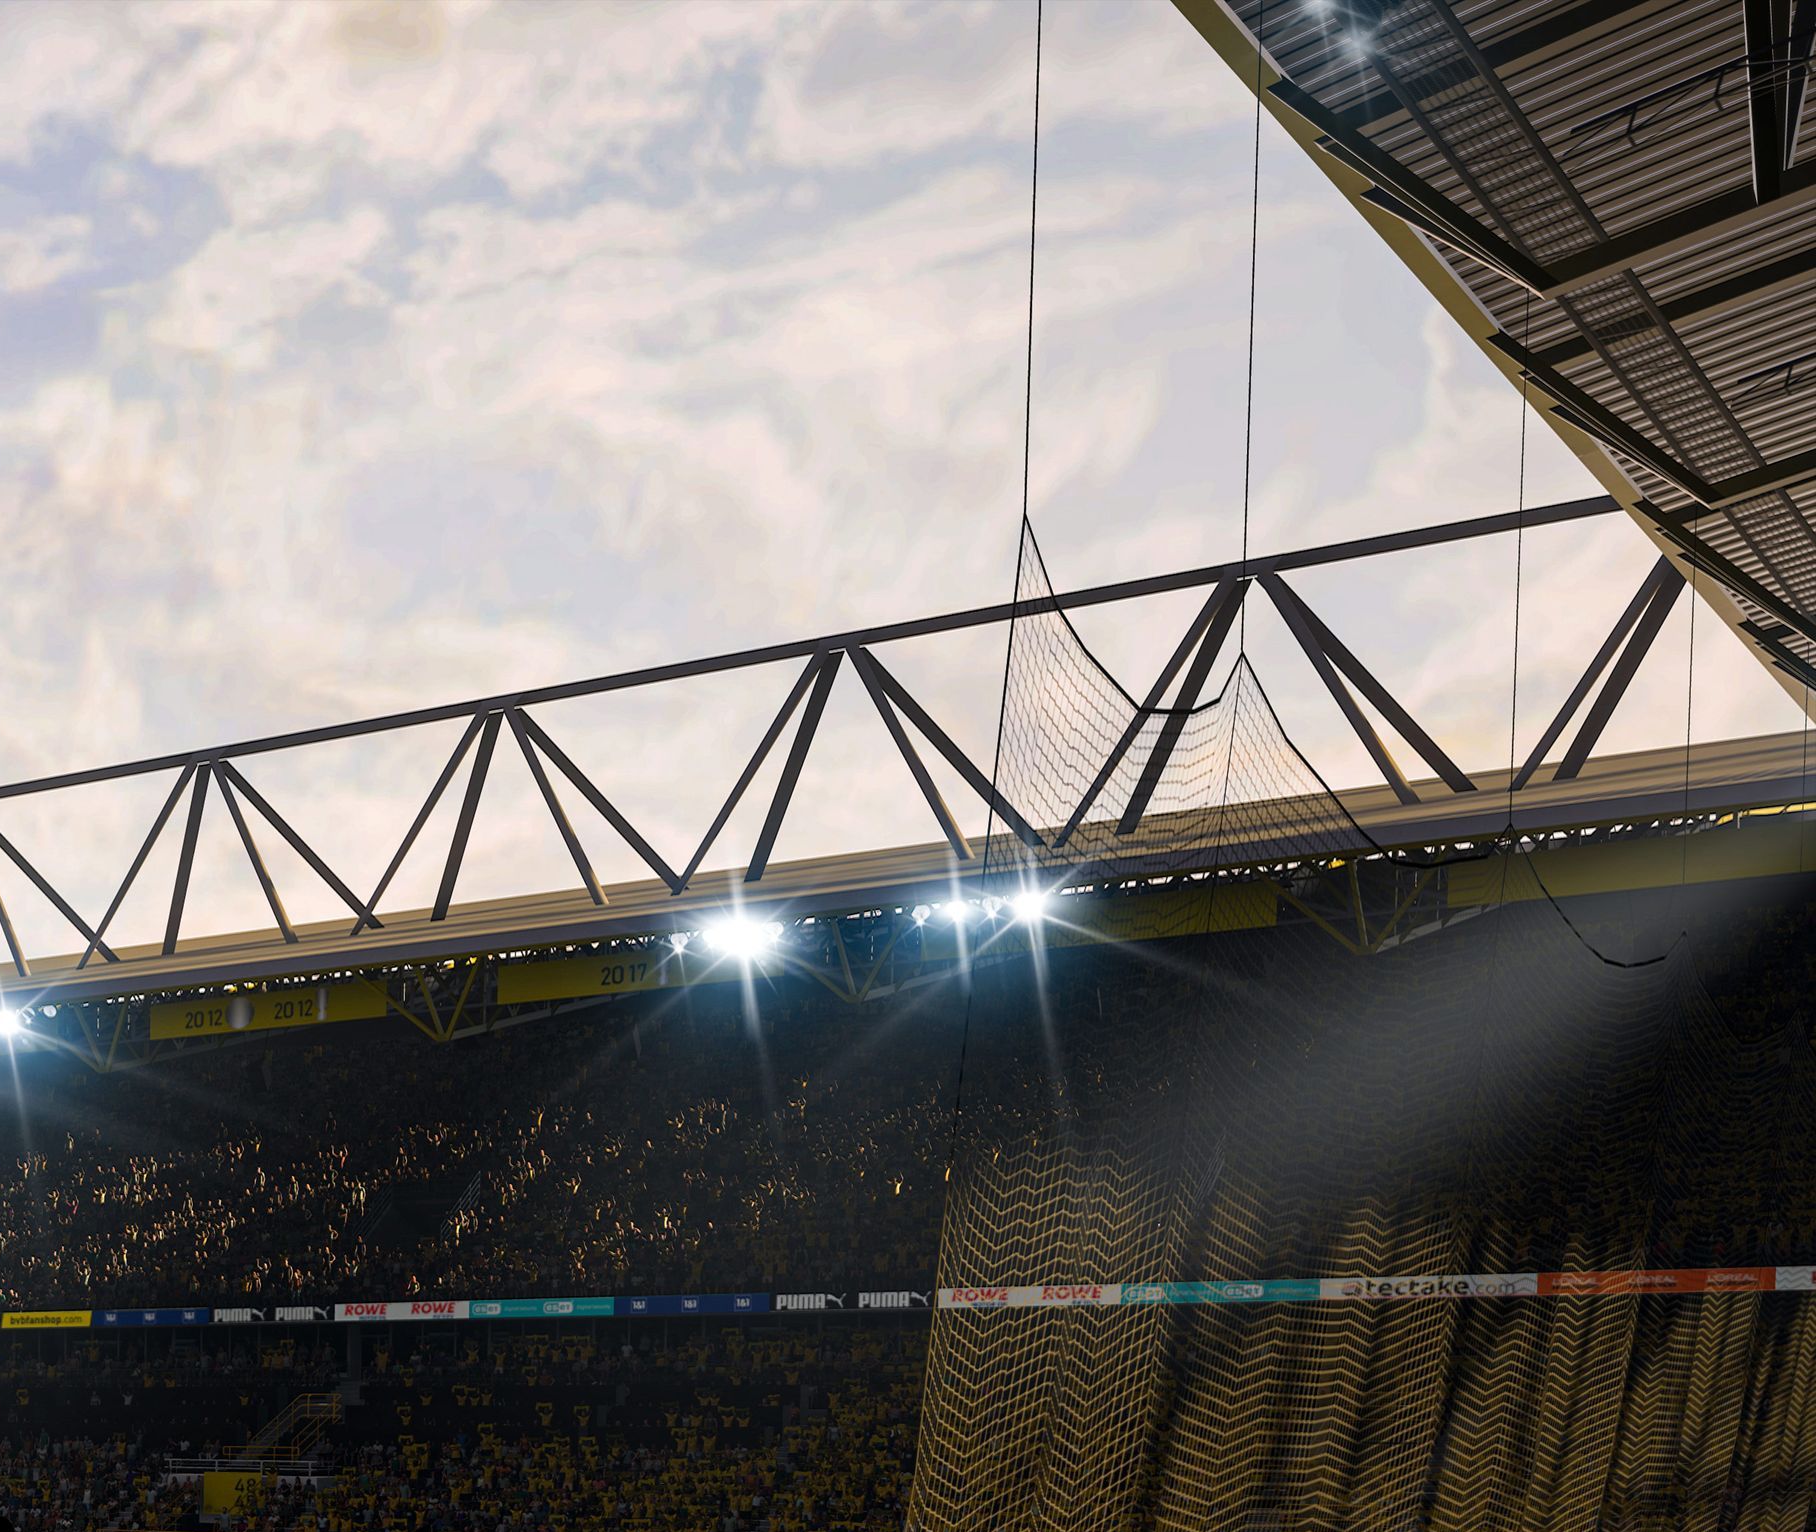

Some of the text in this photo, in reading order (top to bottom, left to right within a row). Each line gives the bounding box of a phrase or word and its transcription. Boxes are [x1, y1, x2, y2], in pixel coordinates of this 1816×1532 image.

[274, 1000, 313, 1020] 2012
[184, 1012, 223, 1029] 2012
[859, 1291, 909, 1309] PUMA
[951, 1288, 1008, 1302] ROWE
[1042, 1286, 1103, 1300] ROWE
[412, 1303, 455, 1314] ROWE
[776, 1293, 826, 1310] PUMA
[215, 1308, 251, 1322] PUMA
[276, 1307, 313, 1320] PUMA
[345, 1305, 387, 1316] ROWE
[10, 1313, 83, 1324] bvbfanshop.com
